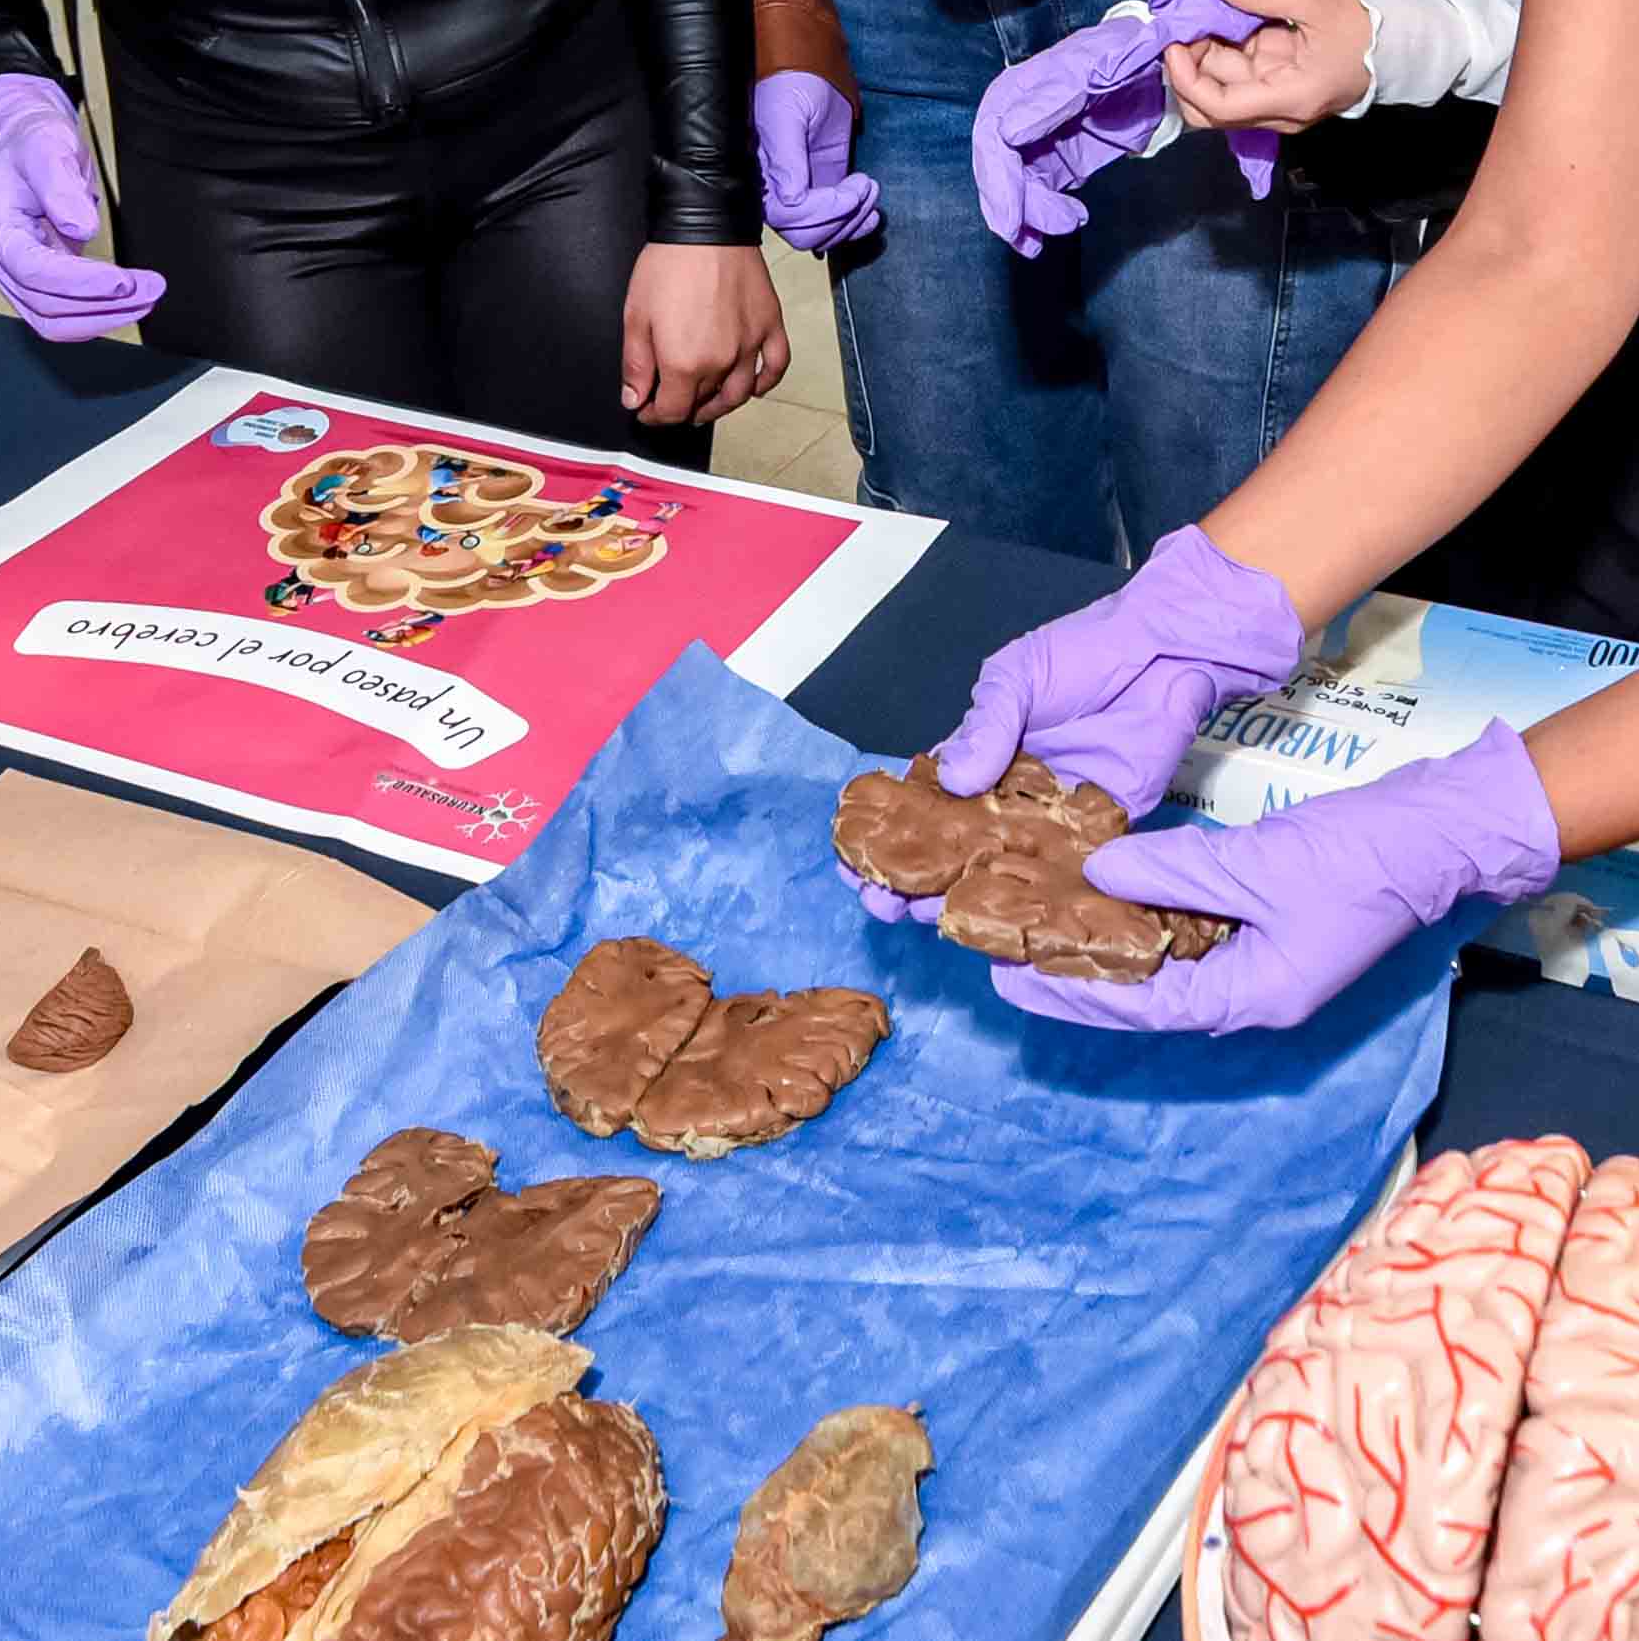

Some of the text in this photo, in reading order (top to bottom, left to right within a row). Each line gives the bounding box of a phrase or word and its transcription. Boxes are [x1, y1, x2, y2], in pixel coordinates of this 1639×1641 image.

[66, 618, 486, 750] Un paseo por el cerebro
[1196, 697, 1378, 771] AMBIDER
[392, 779, 487, 817] NEUROSALUD
